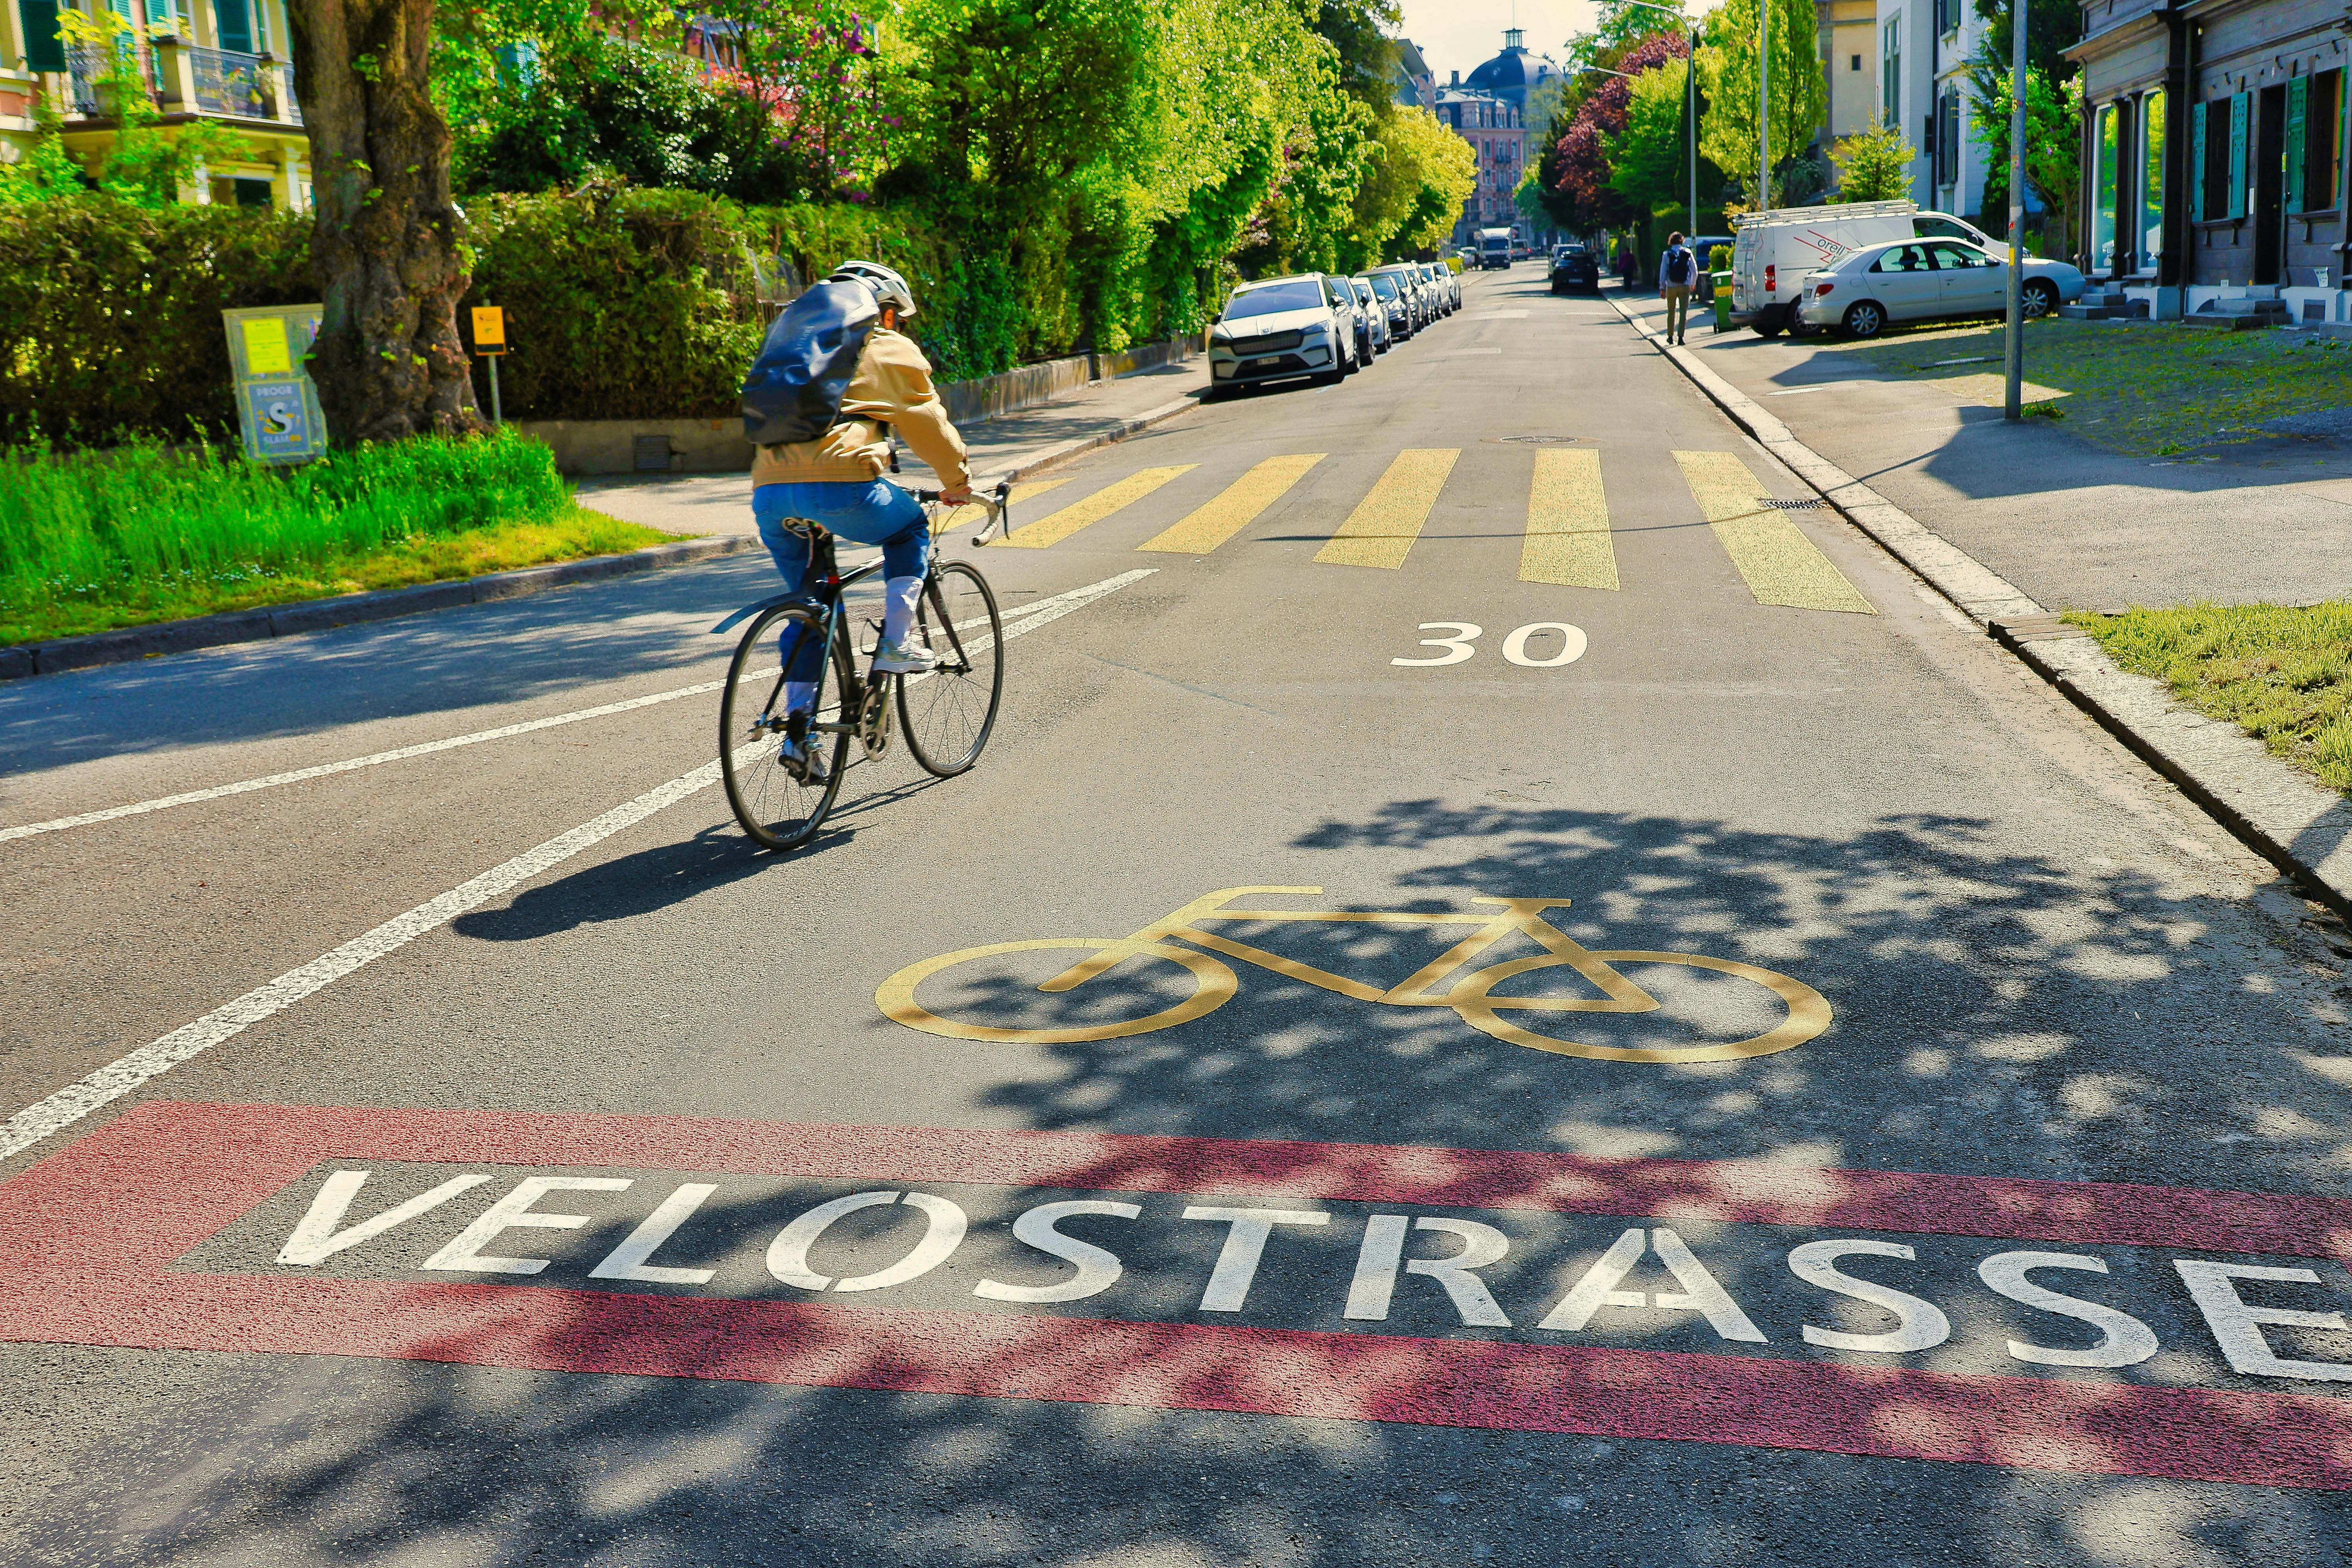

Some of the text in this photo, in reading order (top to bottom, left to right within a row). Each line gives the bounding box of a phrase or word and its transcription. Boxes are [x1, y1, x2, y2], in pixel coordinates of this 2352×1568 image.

[1817, 238, 1846, 255] orell
[1389, 621, 1588, 667] 30
[274, 1169, 2352, 1382] VELOSTRASSE
